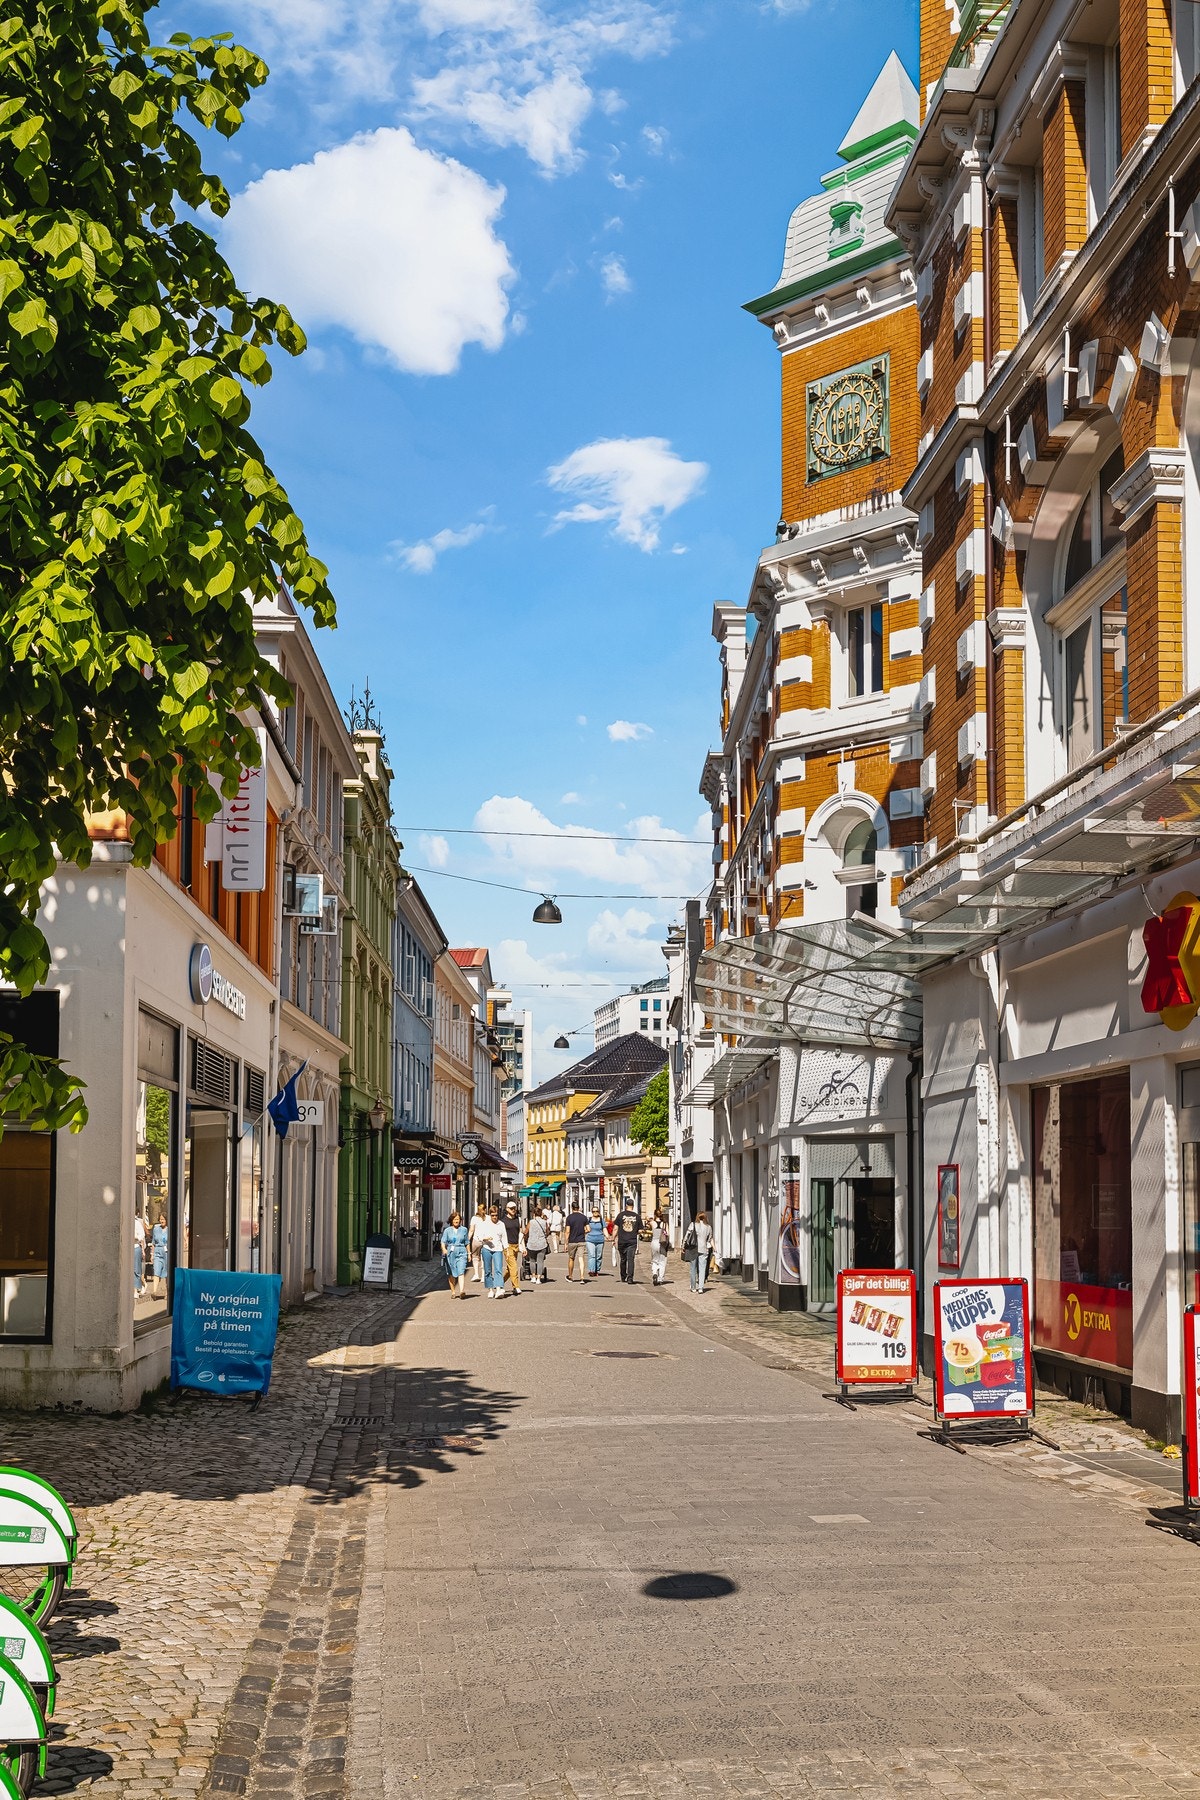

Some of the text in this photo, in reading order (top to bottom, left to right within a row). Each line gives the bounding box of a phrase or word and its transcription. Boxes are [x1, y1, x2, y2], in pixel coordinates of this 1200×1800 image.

[832, 415, 861, 435] 1914
[226, 843, 249, 881] nr1
[399, 1157, 424, 1165] ecco
[429, 1161, 444, 1169] city
[845, 1278, 909, 1291] Gjør det billig!
[200, 1292, 260, 1306] Ny original
[194, 1307, 262, 1319] mobilskjerm
[947, 1298, 996, 1332] KUPP!
[203, 1320, 251, 1332] på timen
[1083, 1311, 1111, 1331] EXTRA
[881, 1342, 907, 1358] 119
[952, 1342, 969, 1356] 75
